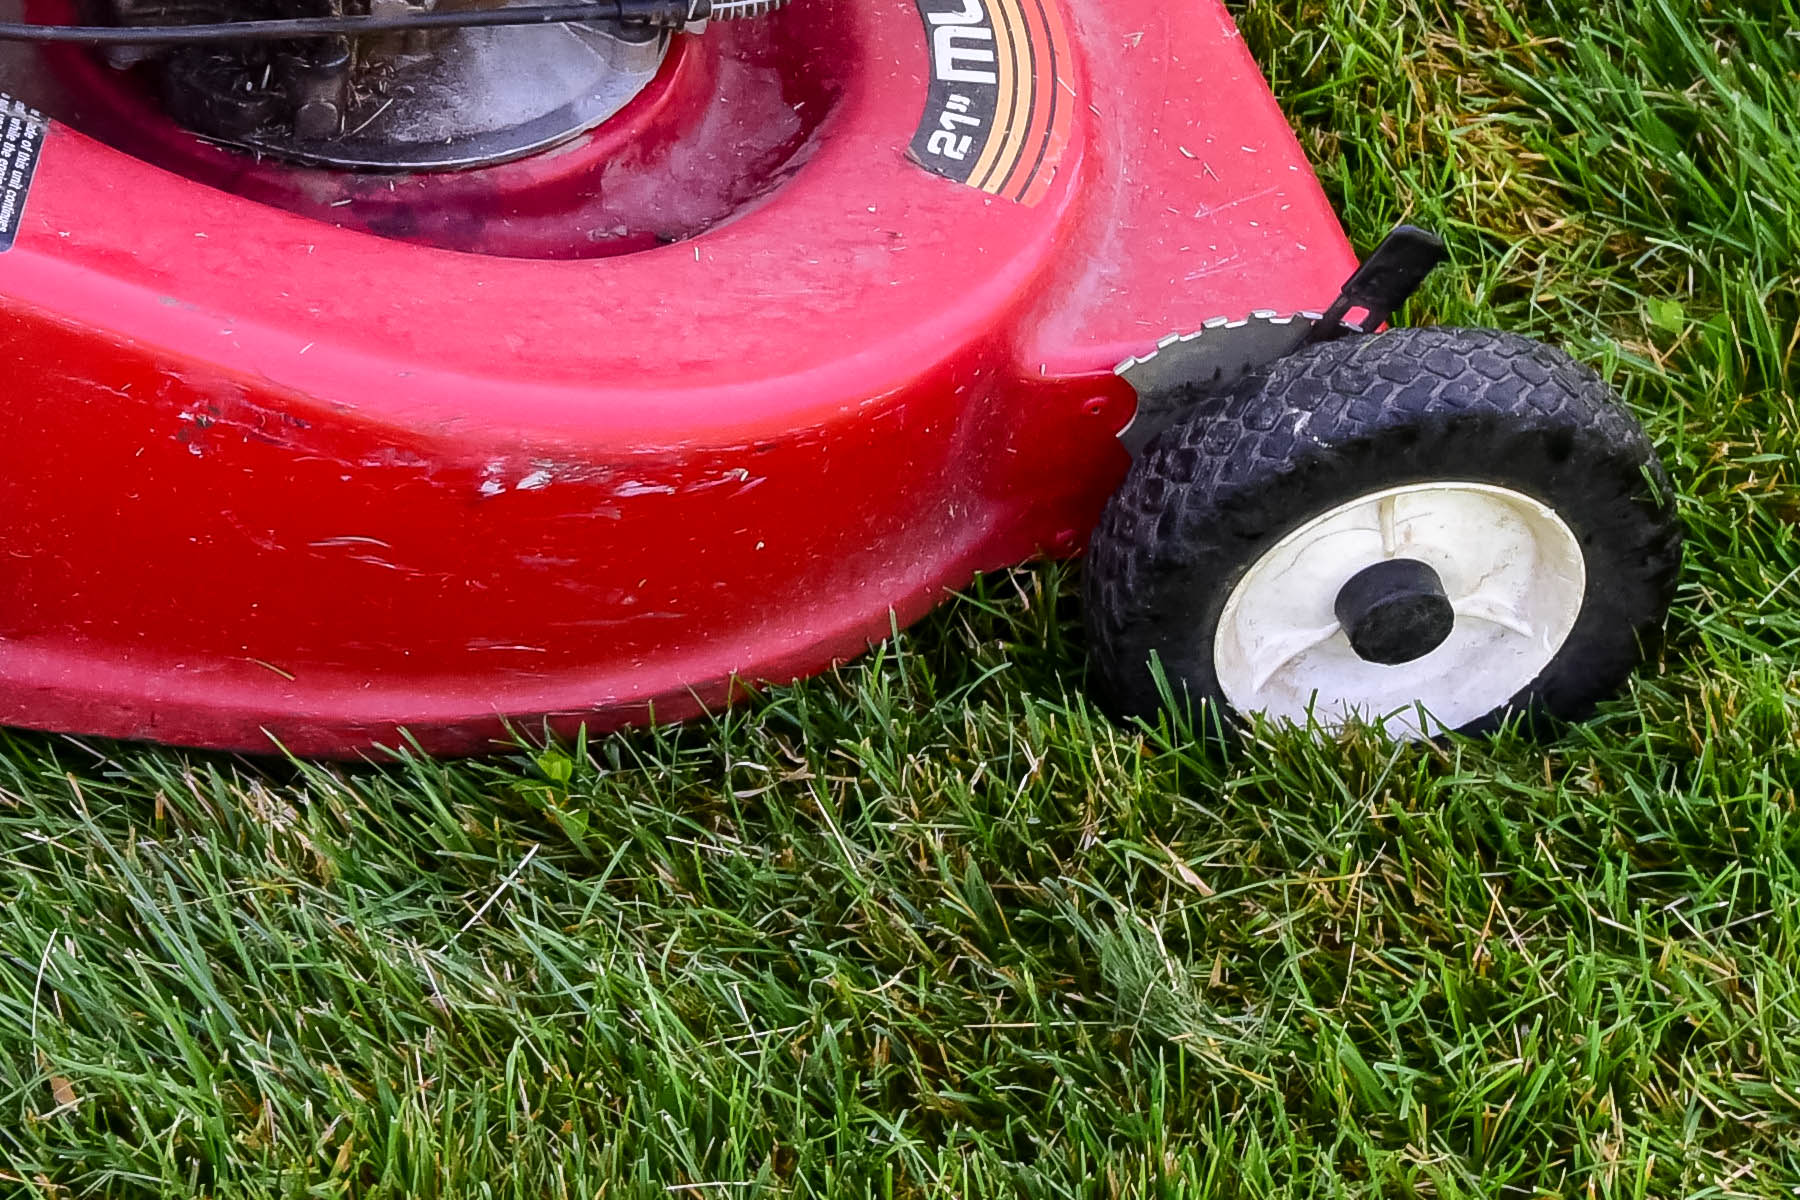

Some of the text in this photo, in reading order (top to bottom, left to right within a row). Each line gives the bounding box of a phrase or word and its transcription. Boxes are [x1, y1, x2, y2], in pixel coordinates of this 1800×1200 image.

[6, 118, 21, 141] while
[927, 94, 984, 161] 21"
[1, 142, 15, 157] the
[21, 140, 32, 152] of
[15, 151, 30, 169] this
[8, 170, 22, 189] unit
